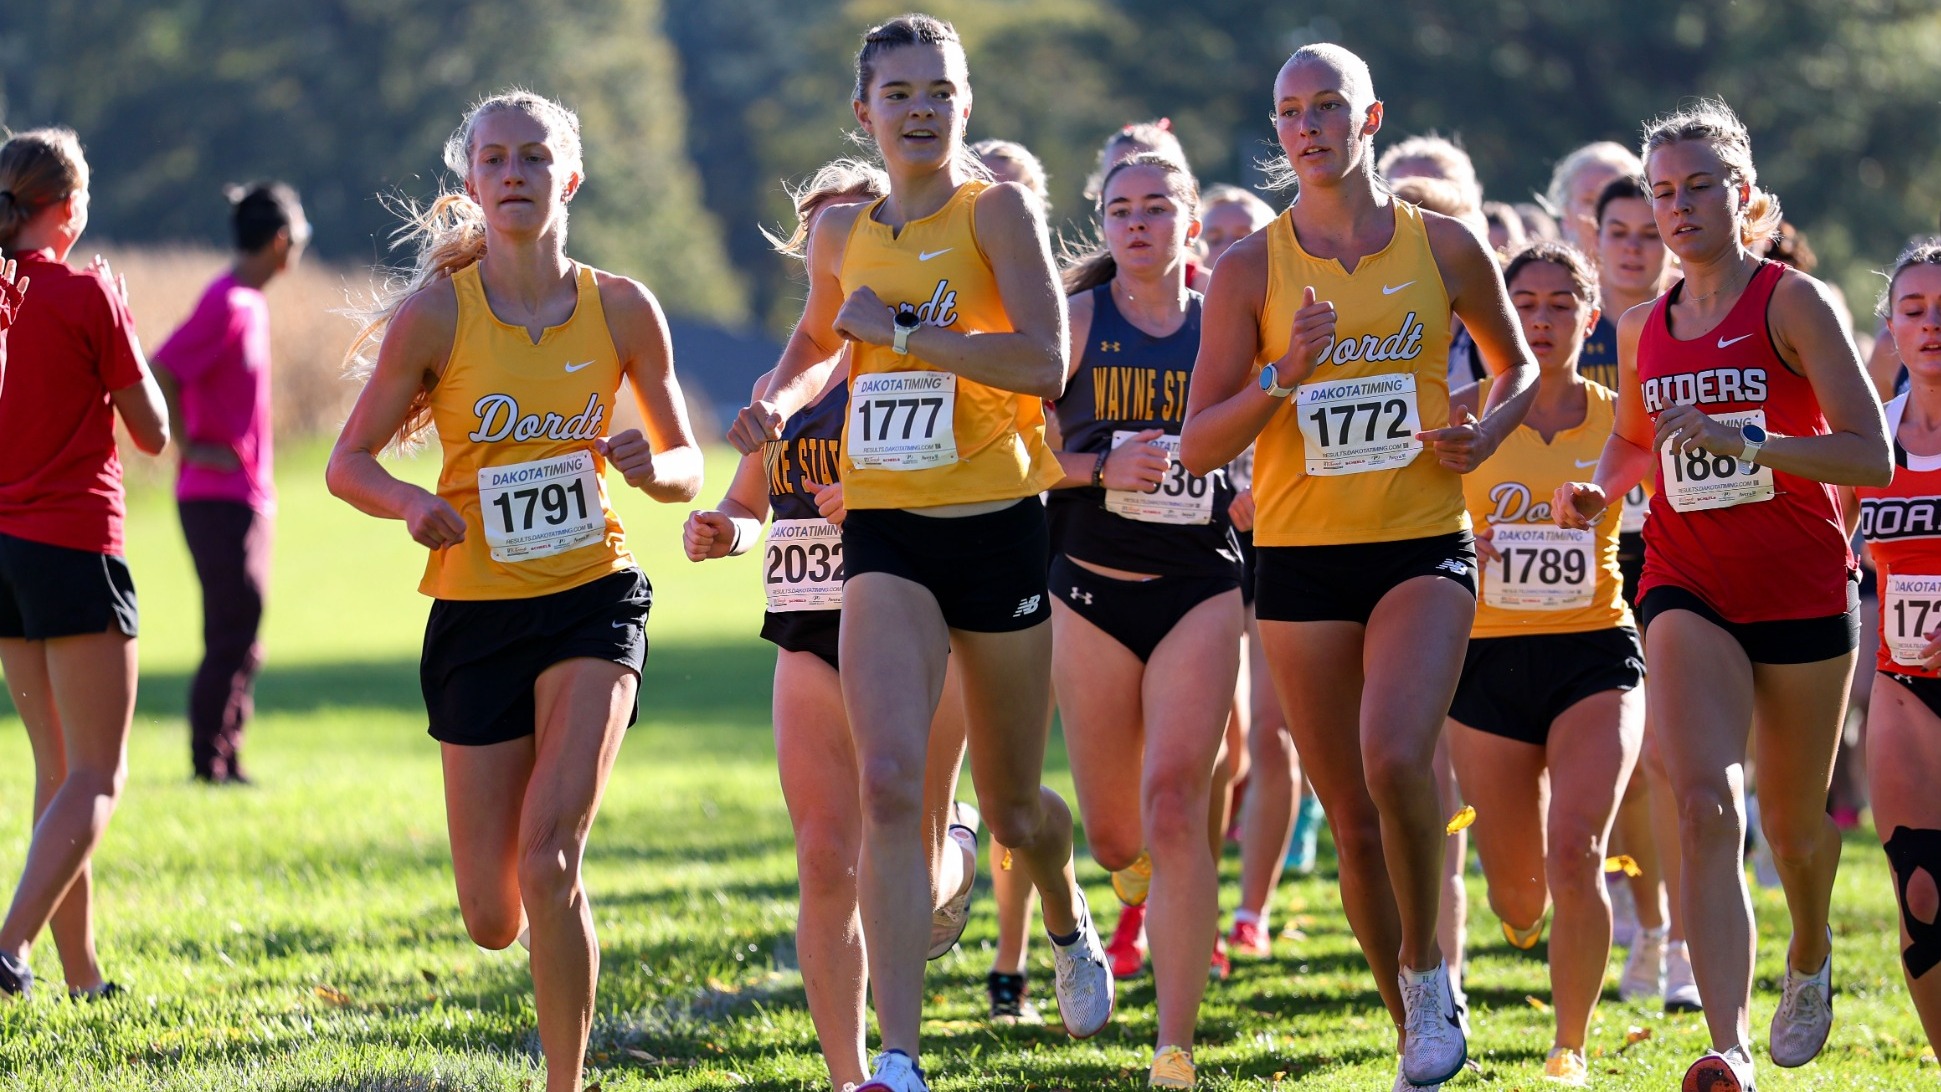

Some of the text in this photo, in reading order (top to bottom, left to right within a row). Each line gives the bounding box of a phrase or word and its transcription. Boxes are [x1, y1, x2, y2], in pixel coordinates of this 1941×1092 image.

[861, 378, 942, 392] DAKOTATIMING
[1093, 367, 1157, 421] WAYNE
[1310, 380, 1403, 401] DAKOTATIMING
[1641, 367, 1768, 414] AIDERS
[468, 393, 605, 443] Dordt
[858, 398, 944, 441] 1777
[1309, 399, 1412, 447] 1772
[492, 459, 583, 486] DAKOTATIMING
[798, 438, 842, 493] STAT
[493, 478, 587, 533] 1791
[1498, 531, 1583, 541] DAKOTATIMING
[767, 543, 845, 584] 2032
[1500, 548, 1586, 585] 1789
[1895, 581, 1941, 592] DAKOTAT
[1893, 599, 1941, 638] 17
